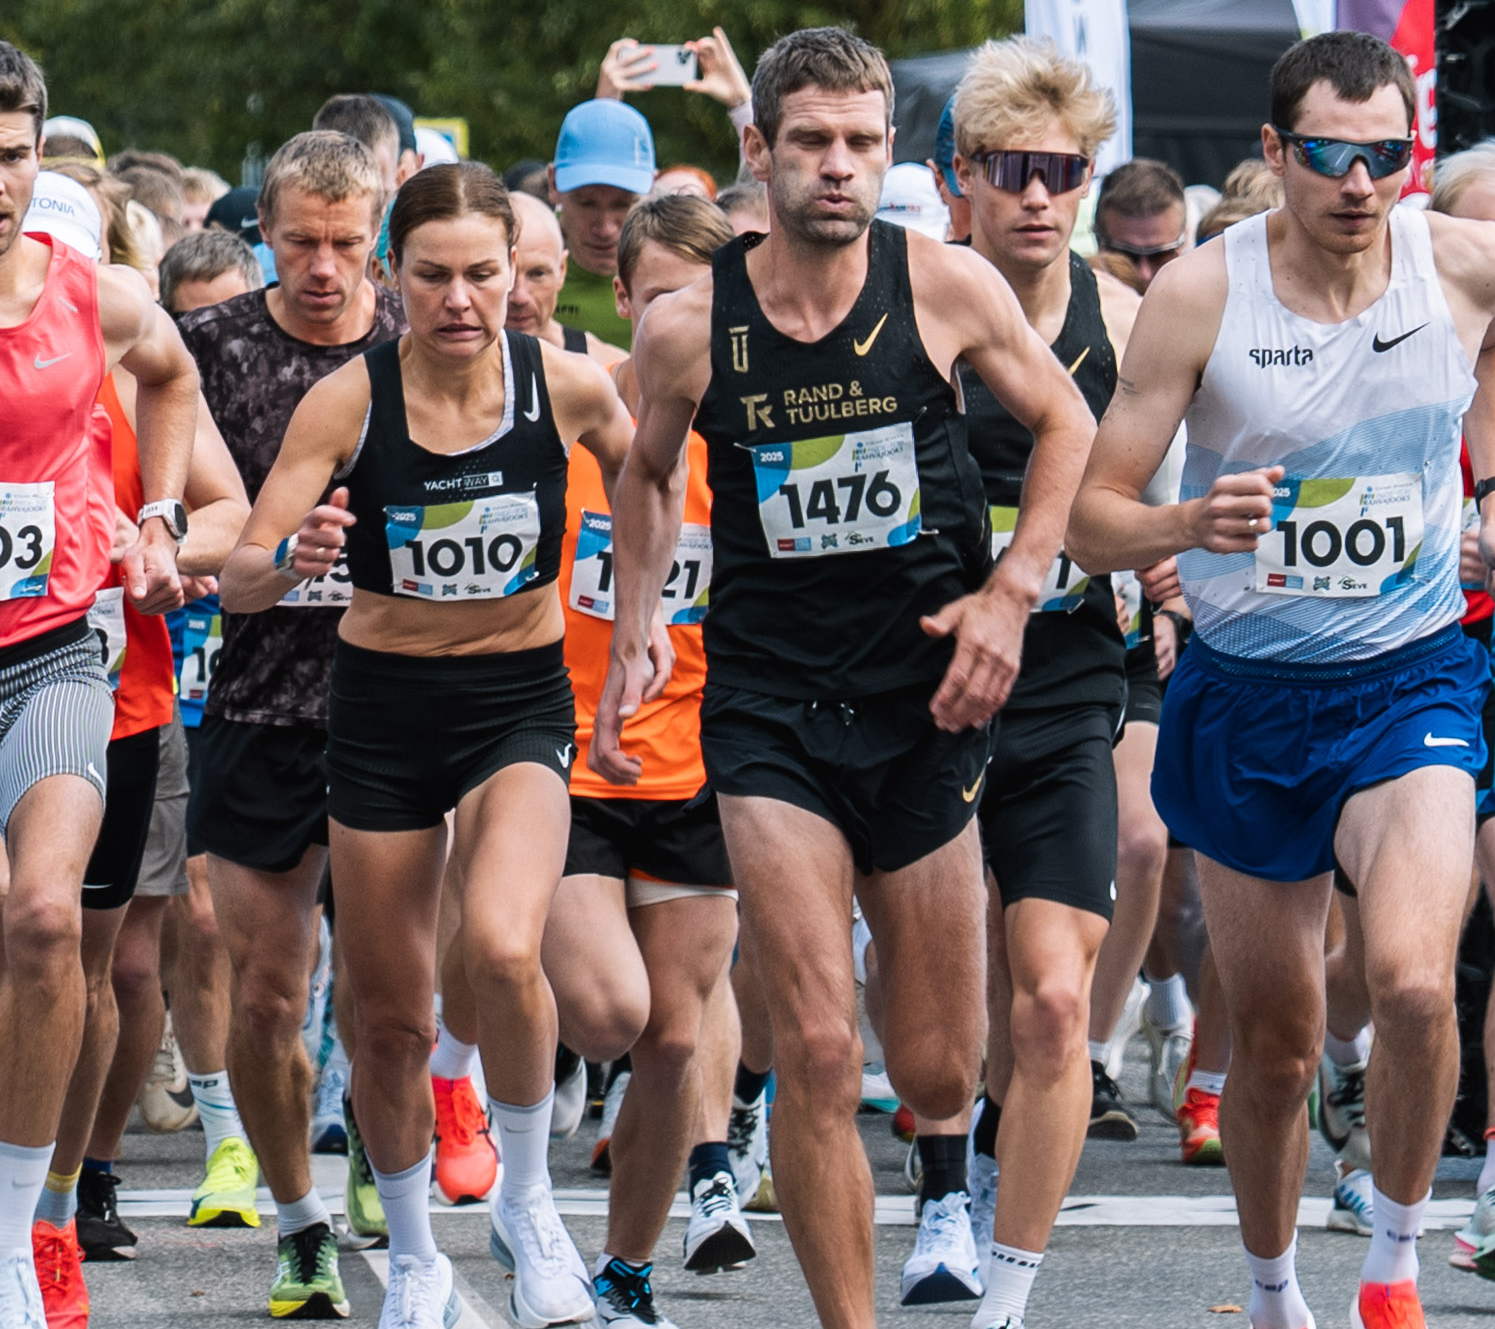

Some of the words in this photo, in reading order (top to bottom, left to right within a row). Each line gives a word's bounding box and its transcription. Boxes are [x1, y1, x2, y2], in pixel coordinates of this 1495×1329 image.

[33, 197, 75, 217] TONIA
[1249, 345, 1314, 369] sparta
[783, 382, 843, 406] RAND
[849, 380, 863, 397] &
[786, 396, 898, 424] TUULBERG
[760, 451, 784, 463] 2025
[779, 470, 902, 529] 1476
[1273, 487, 1291, 498] 025
[405, 533, 523, 577] 1010
[1276, 516, 1406, 568] 1001
[596, 549, 701, 600] 121
